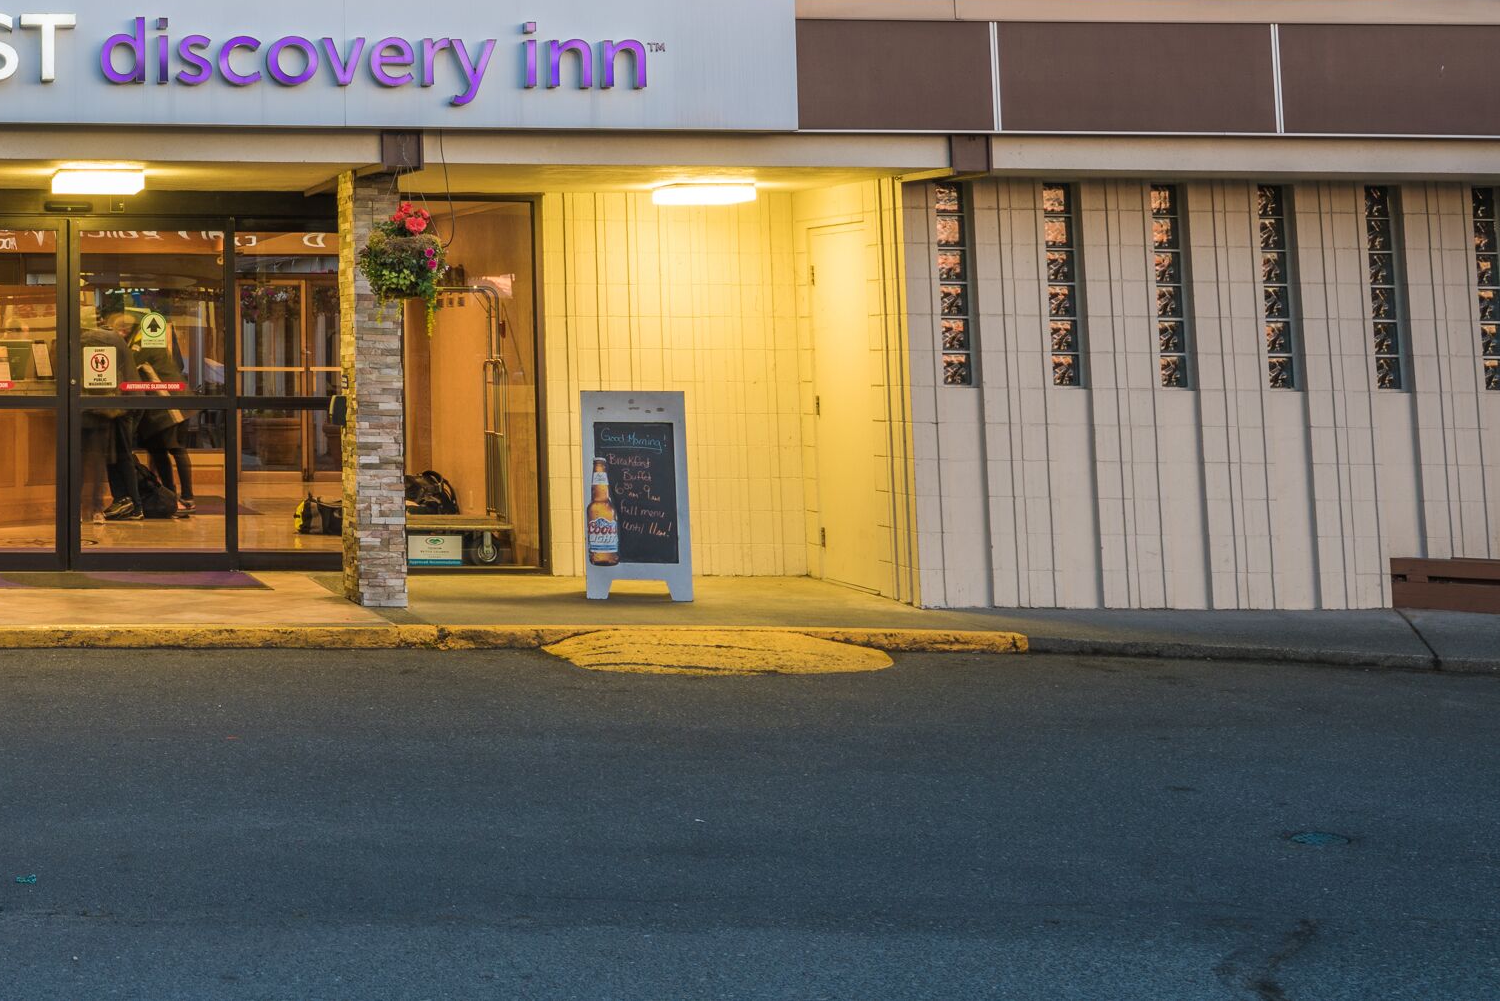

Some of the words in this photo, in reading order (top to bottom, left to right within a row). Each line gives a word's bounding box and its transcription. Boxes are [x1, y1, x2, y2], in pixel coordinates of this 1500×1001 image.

[99, 16, 497, 106] discovery
[522, 21, 647, 89] inn
[601, 427, 625, 443] Good
[607, 453, 651, 468] Breakfast
[622, 469, 651, 481] Buffet
[640, 509, 665, 518] menu
[588, 521, 618, 534] Coors
